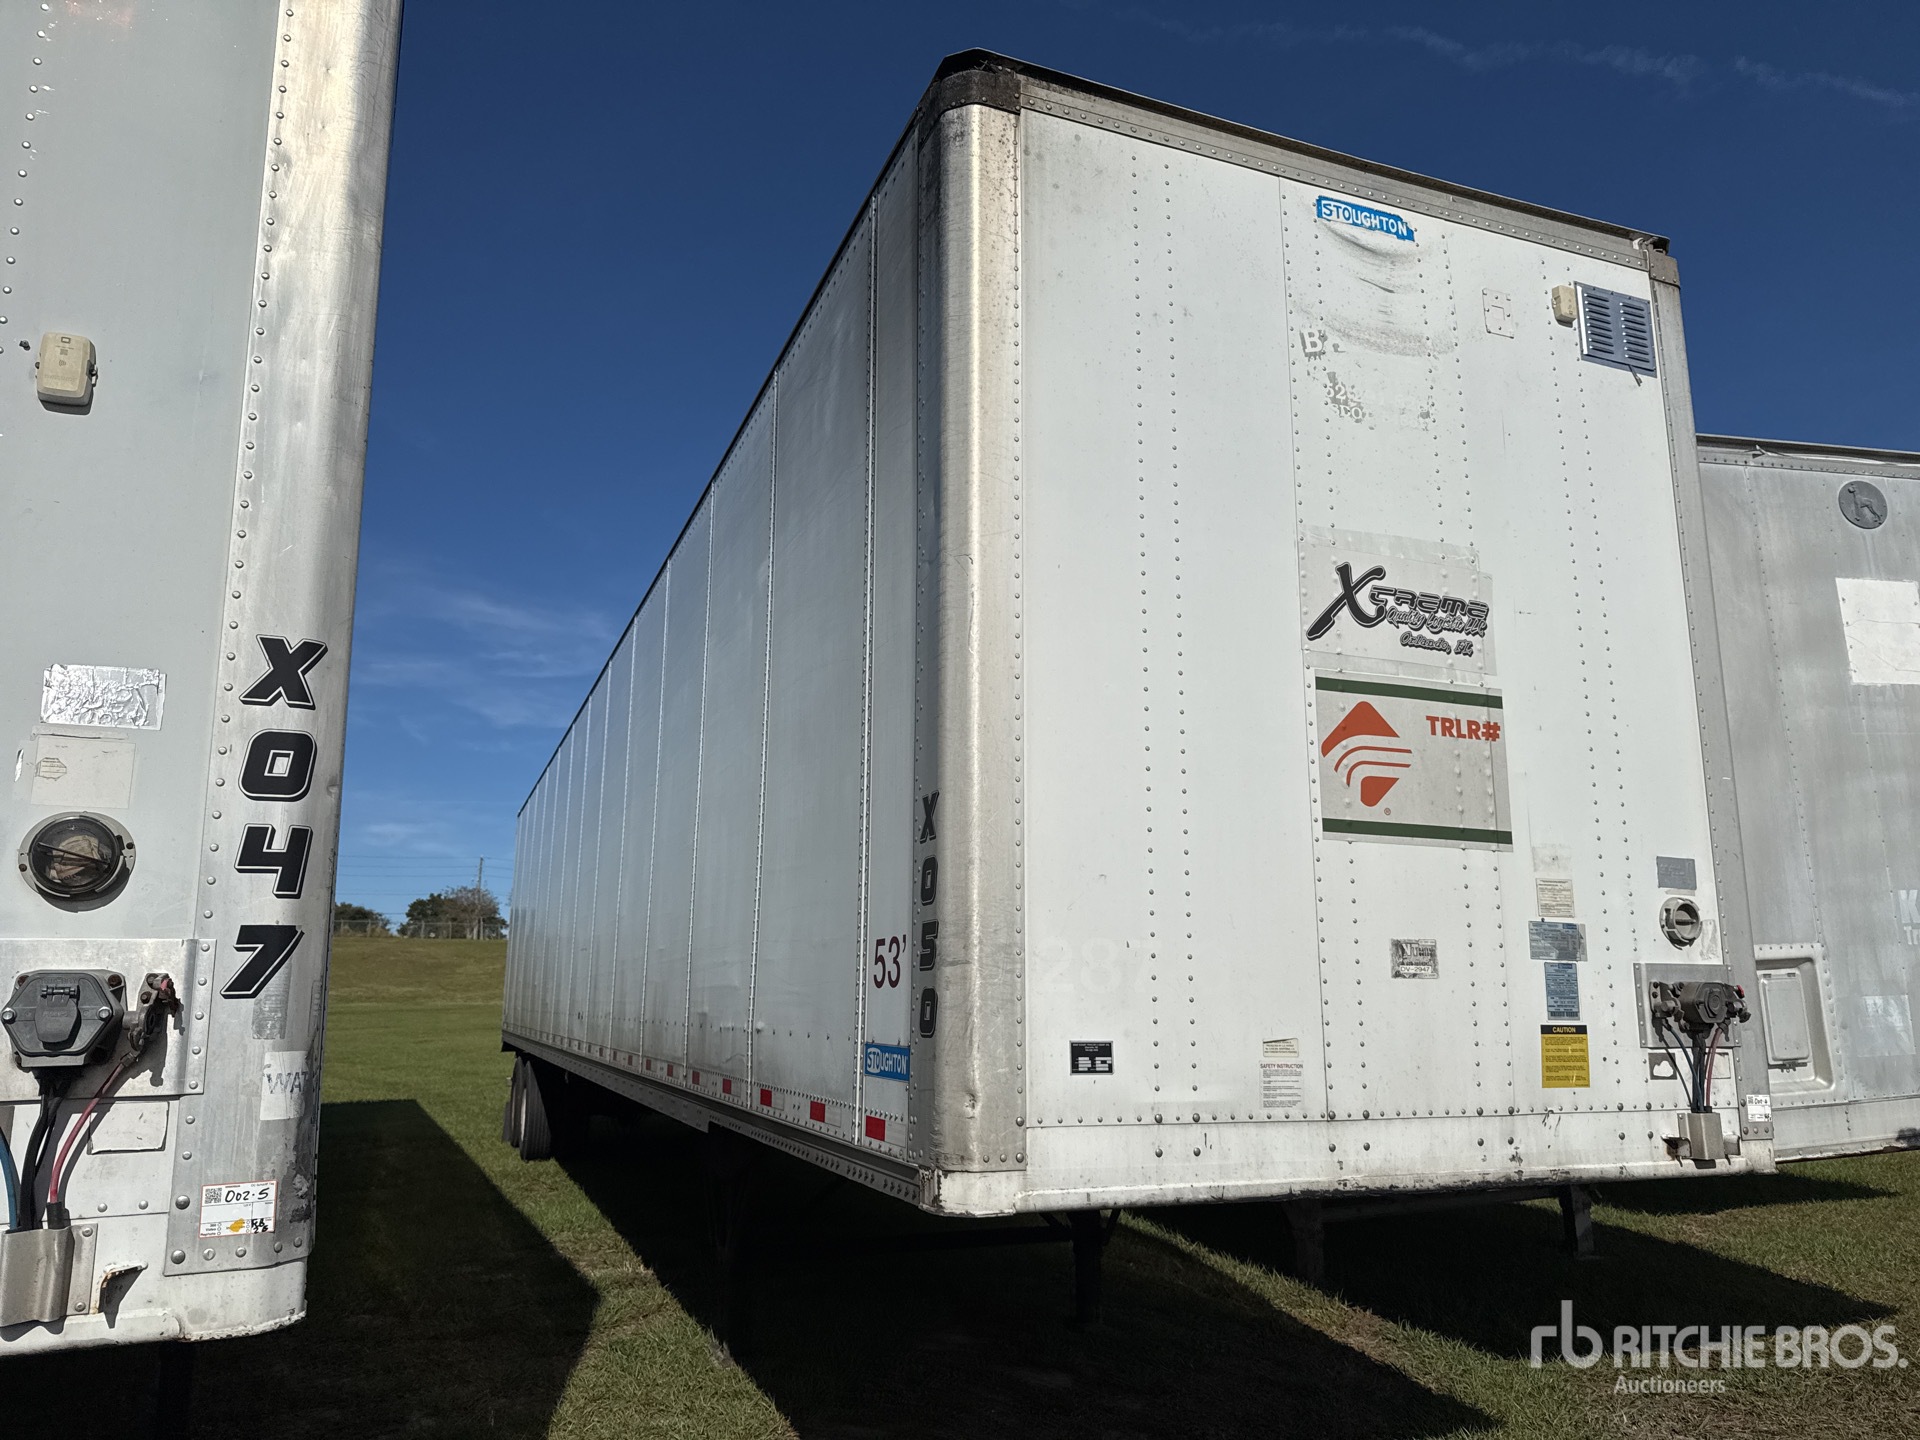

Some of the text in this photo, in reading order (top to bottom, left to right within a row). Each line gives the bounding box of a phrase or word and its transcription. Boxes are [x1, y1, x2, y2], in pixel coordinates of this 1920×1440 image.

[1320, 199, 1411, 238] STOUGHTON
[1400, 631, 1474, 657] Orlando, FL
[1426, 715, 1501, 742] TRLR#
[220, 634, 328, 1000] X047
[918, 790, 940, 1039] X050
[873, 934, 907, 989] 53'
[867, 1047, 908, 1075] STOUGHTON
